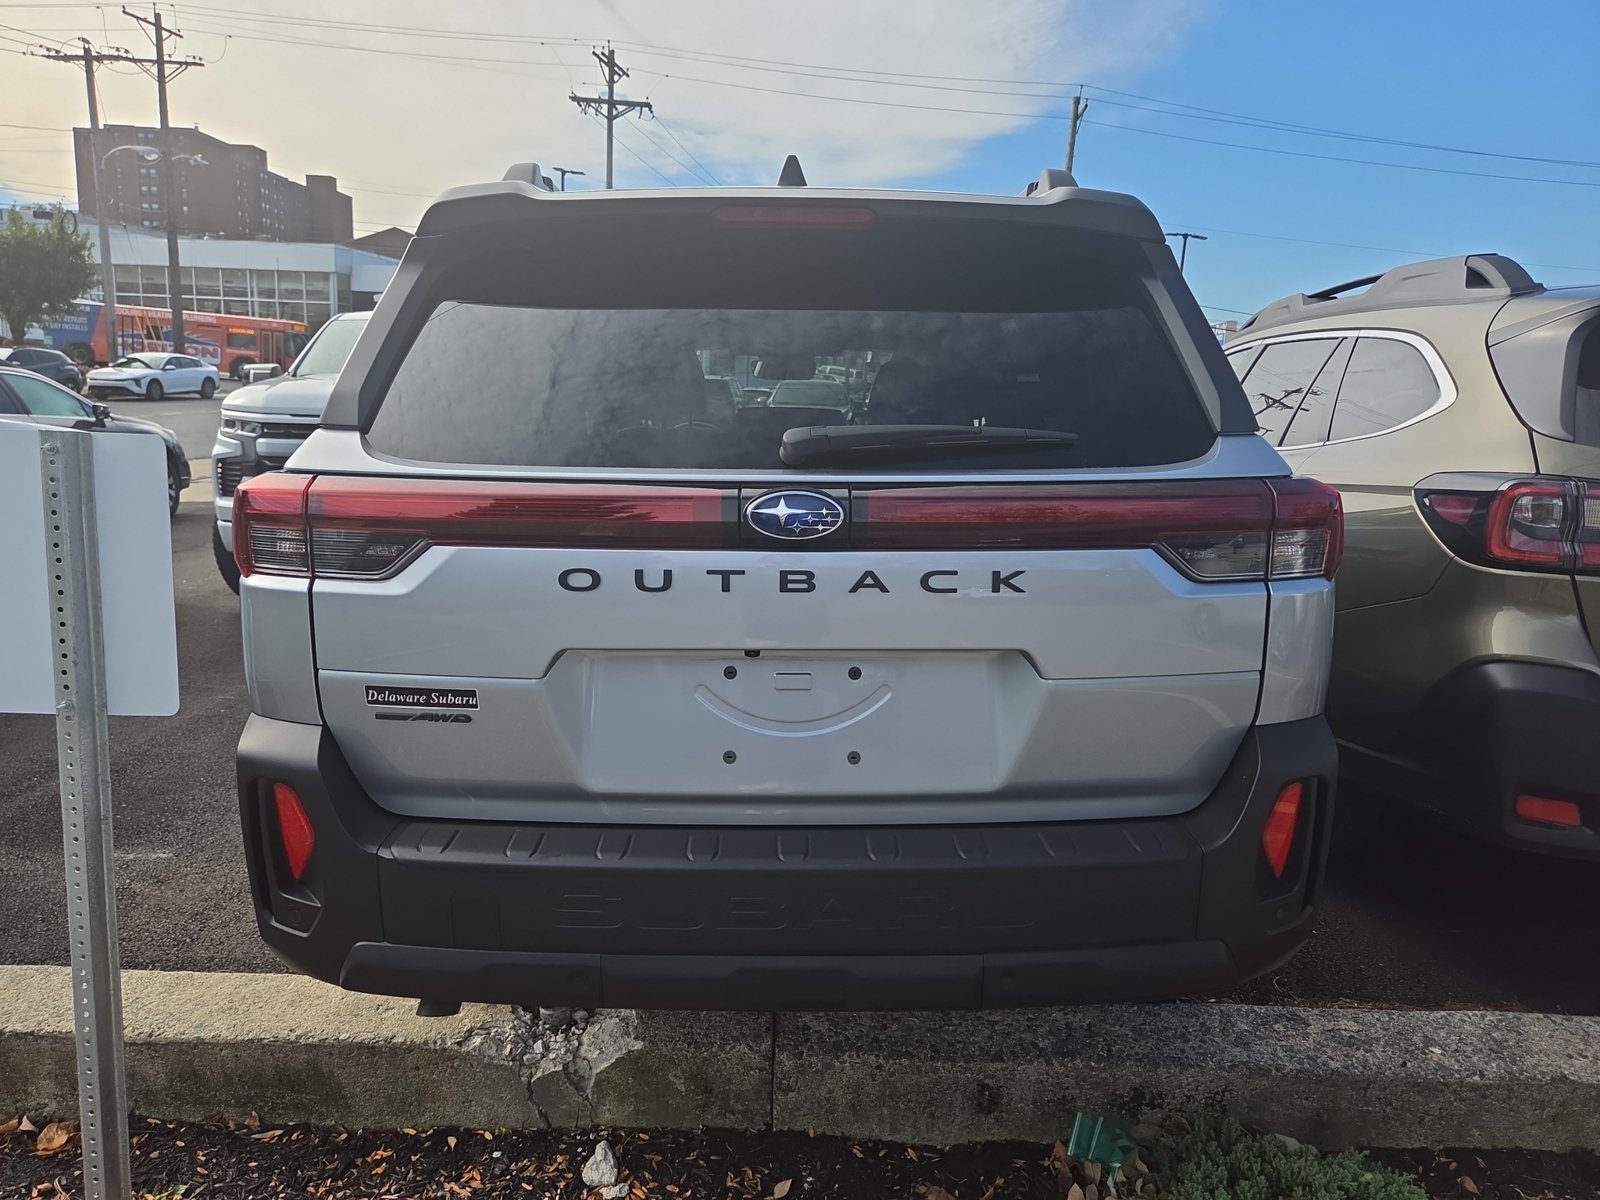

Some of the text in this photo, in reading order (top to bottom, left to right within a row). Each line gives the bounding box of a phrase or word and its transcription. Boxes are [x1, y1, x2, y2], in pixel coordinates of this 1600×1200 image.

[148, 309, 173, 319] HEATIN
[182, 313, 217, 323] PLUMBING
[62, 322, 89, 332] INSTALLS
[558, 567, 1027, 594] OUTBACK
[367, 689, 477, 705] Delaware Subaru
[410, 711, 473, 724] AWD
